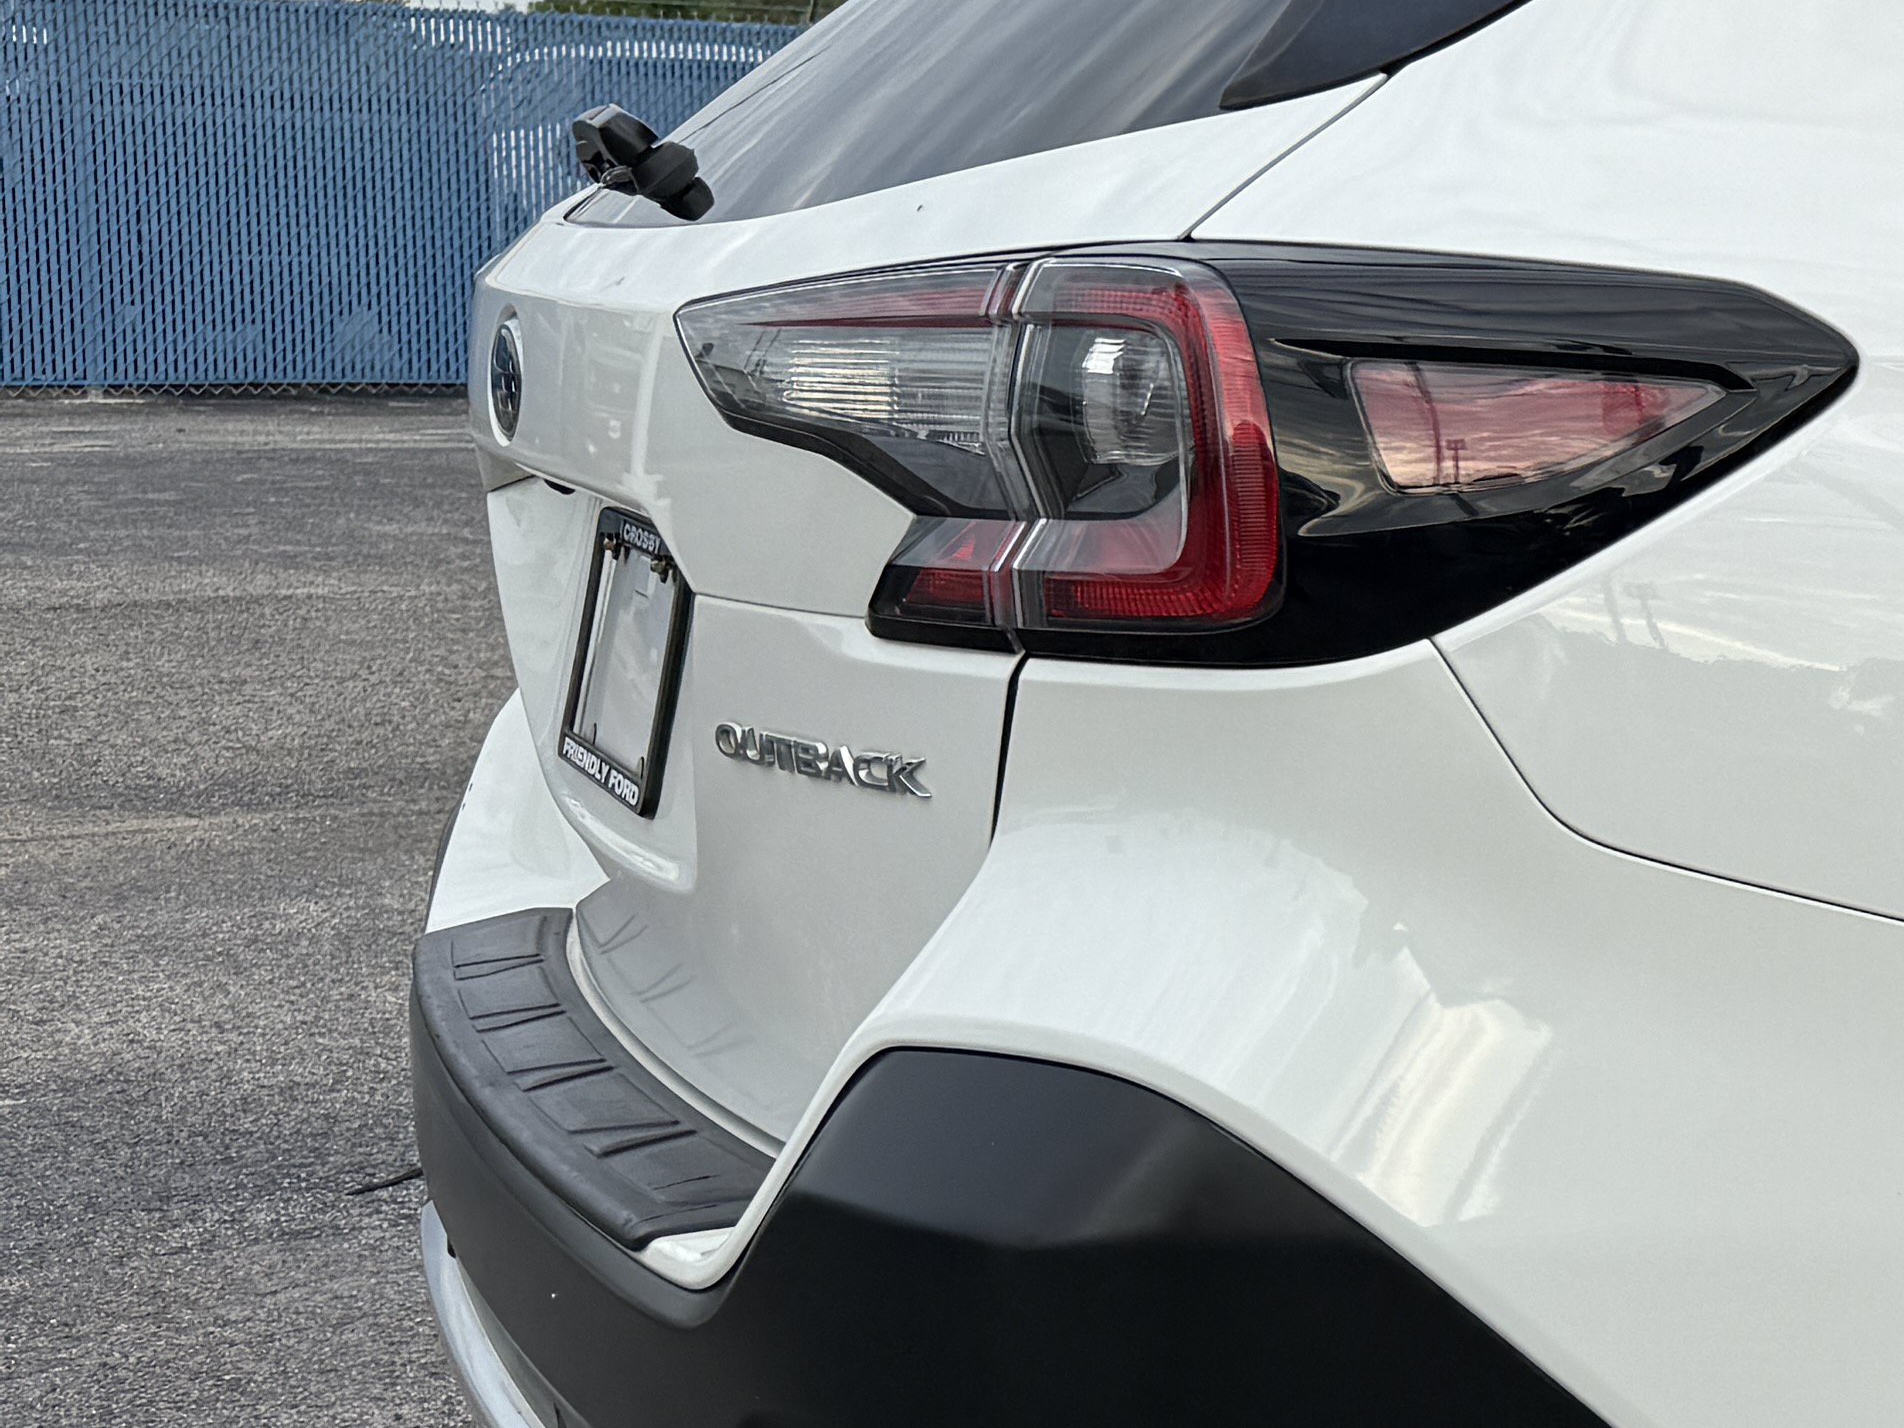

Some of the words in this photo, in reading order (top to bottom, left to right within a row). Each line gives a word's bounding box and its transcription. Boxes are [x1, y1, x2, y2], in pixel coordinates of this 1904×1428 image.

[624, 522, 661, 554] CROSBY
[563, 737, 610, 784] FRIENDLY
[608, 769, 640, 807] FORD
[715, 720, 933, 799] OUTBACK
